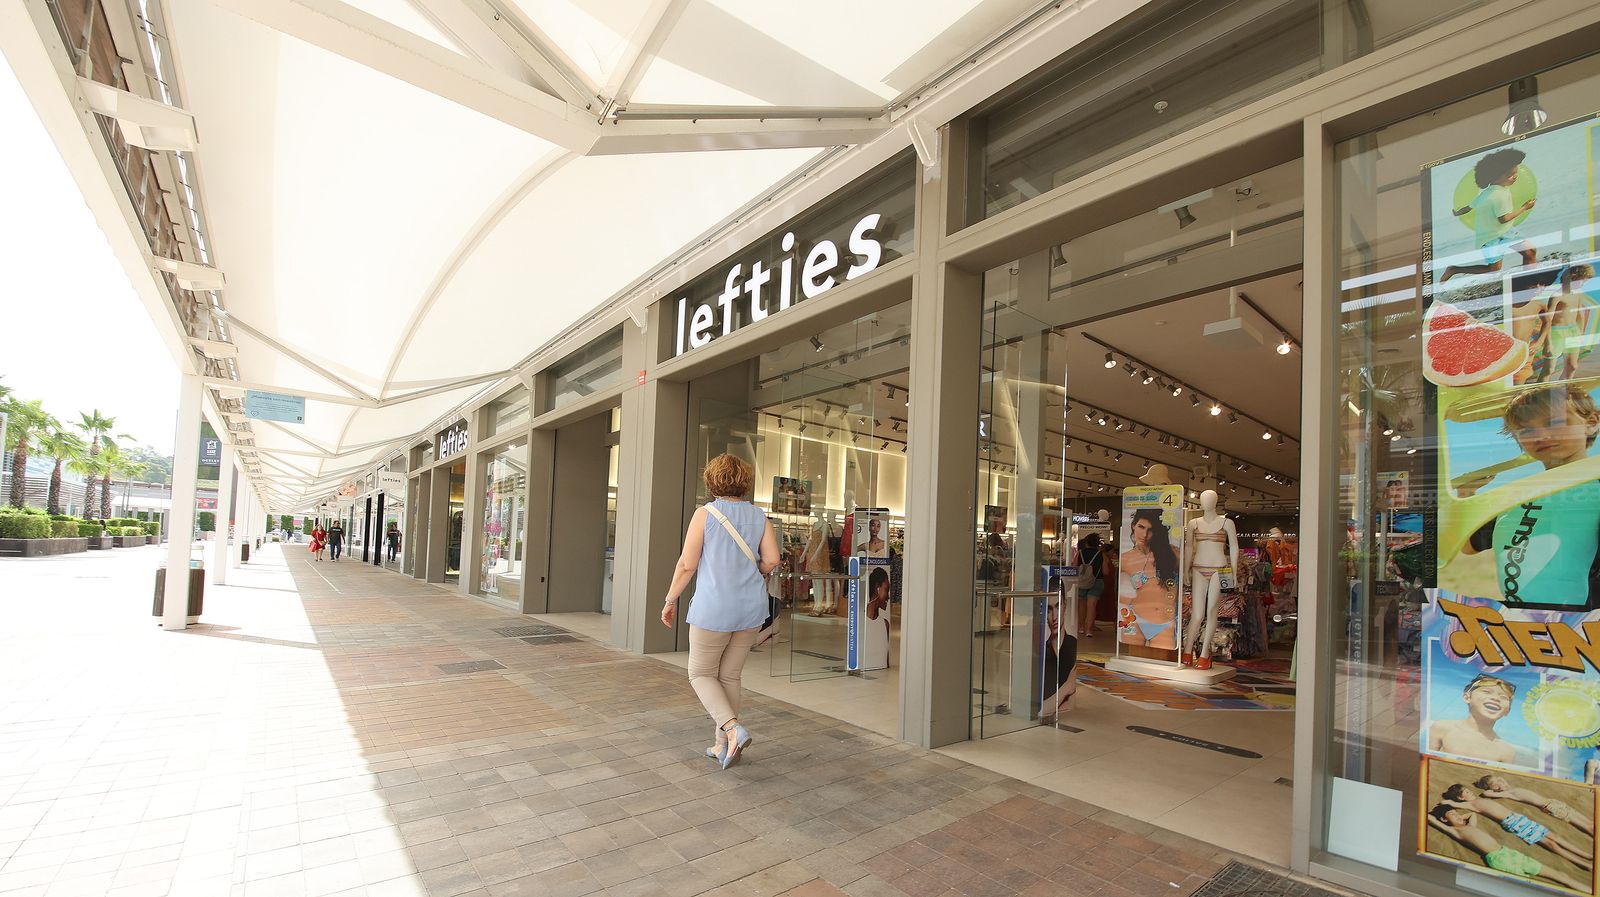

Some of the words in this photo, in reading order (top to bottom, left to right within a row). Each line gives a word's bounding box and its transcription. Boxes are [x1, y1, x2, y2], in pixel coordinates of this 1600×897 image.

[1423, 231, 1431, 263] ENDLESS
[676, 213, 882, 357] lefties
[1423, 265, 1431, 298] SUMMER
[440, 425, 468, 460] lefties
[1162, 494, 1173, 506] 4
[1424, 528, 1434, 579] COLLECTION
[1220, 579, 1229, 589] 6
